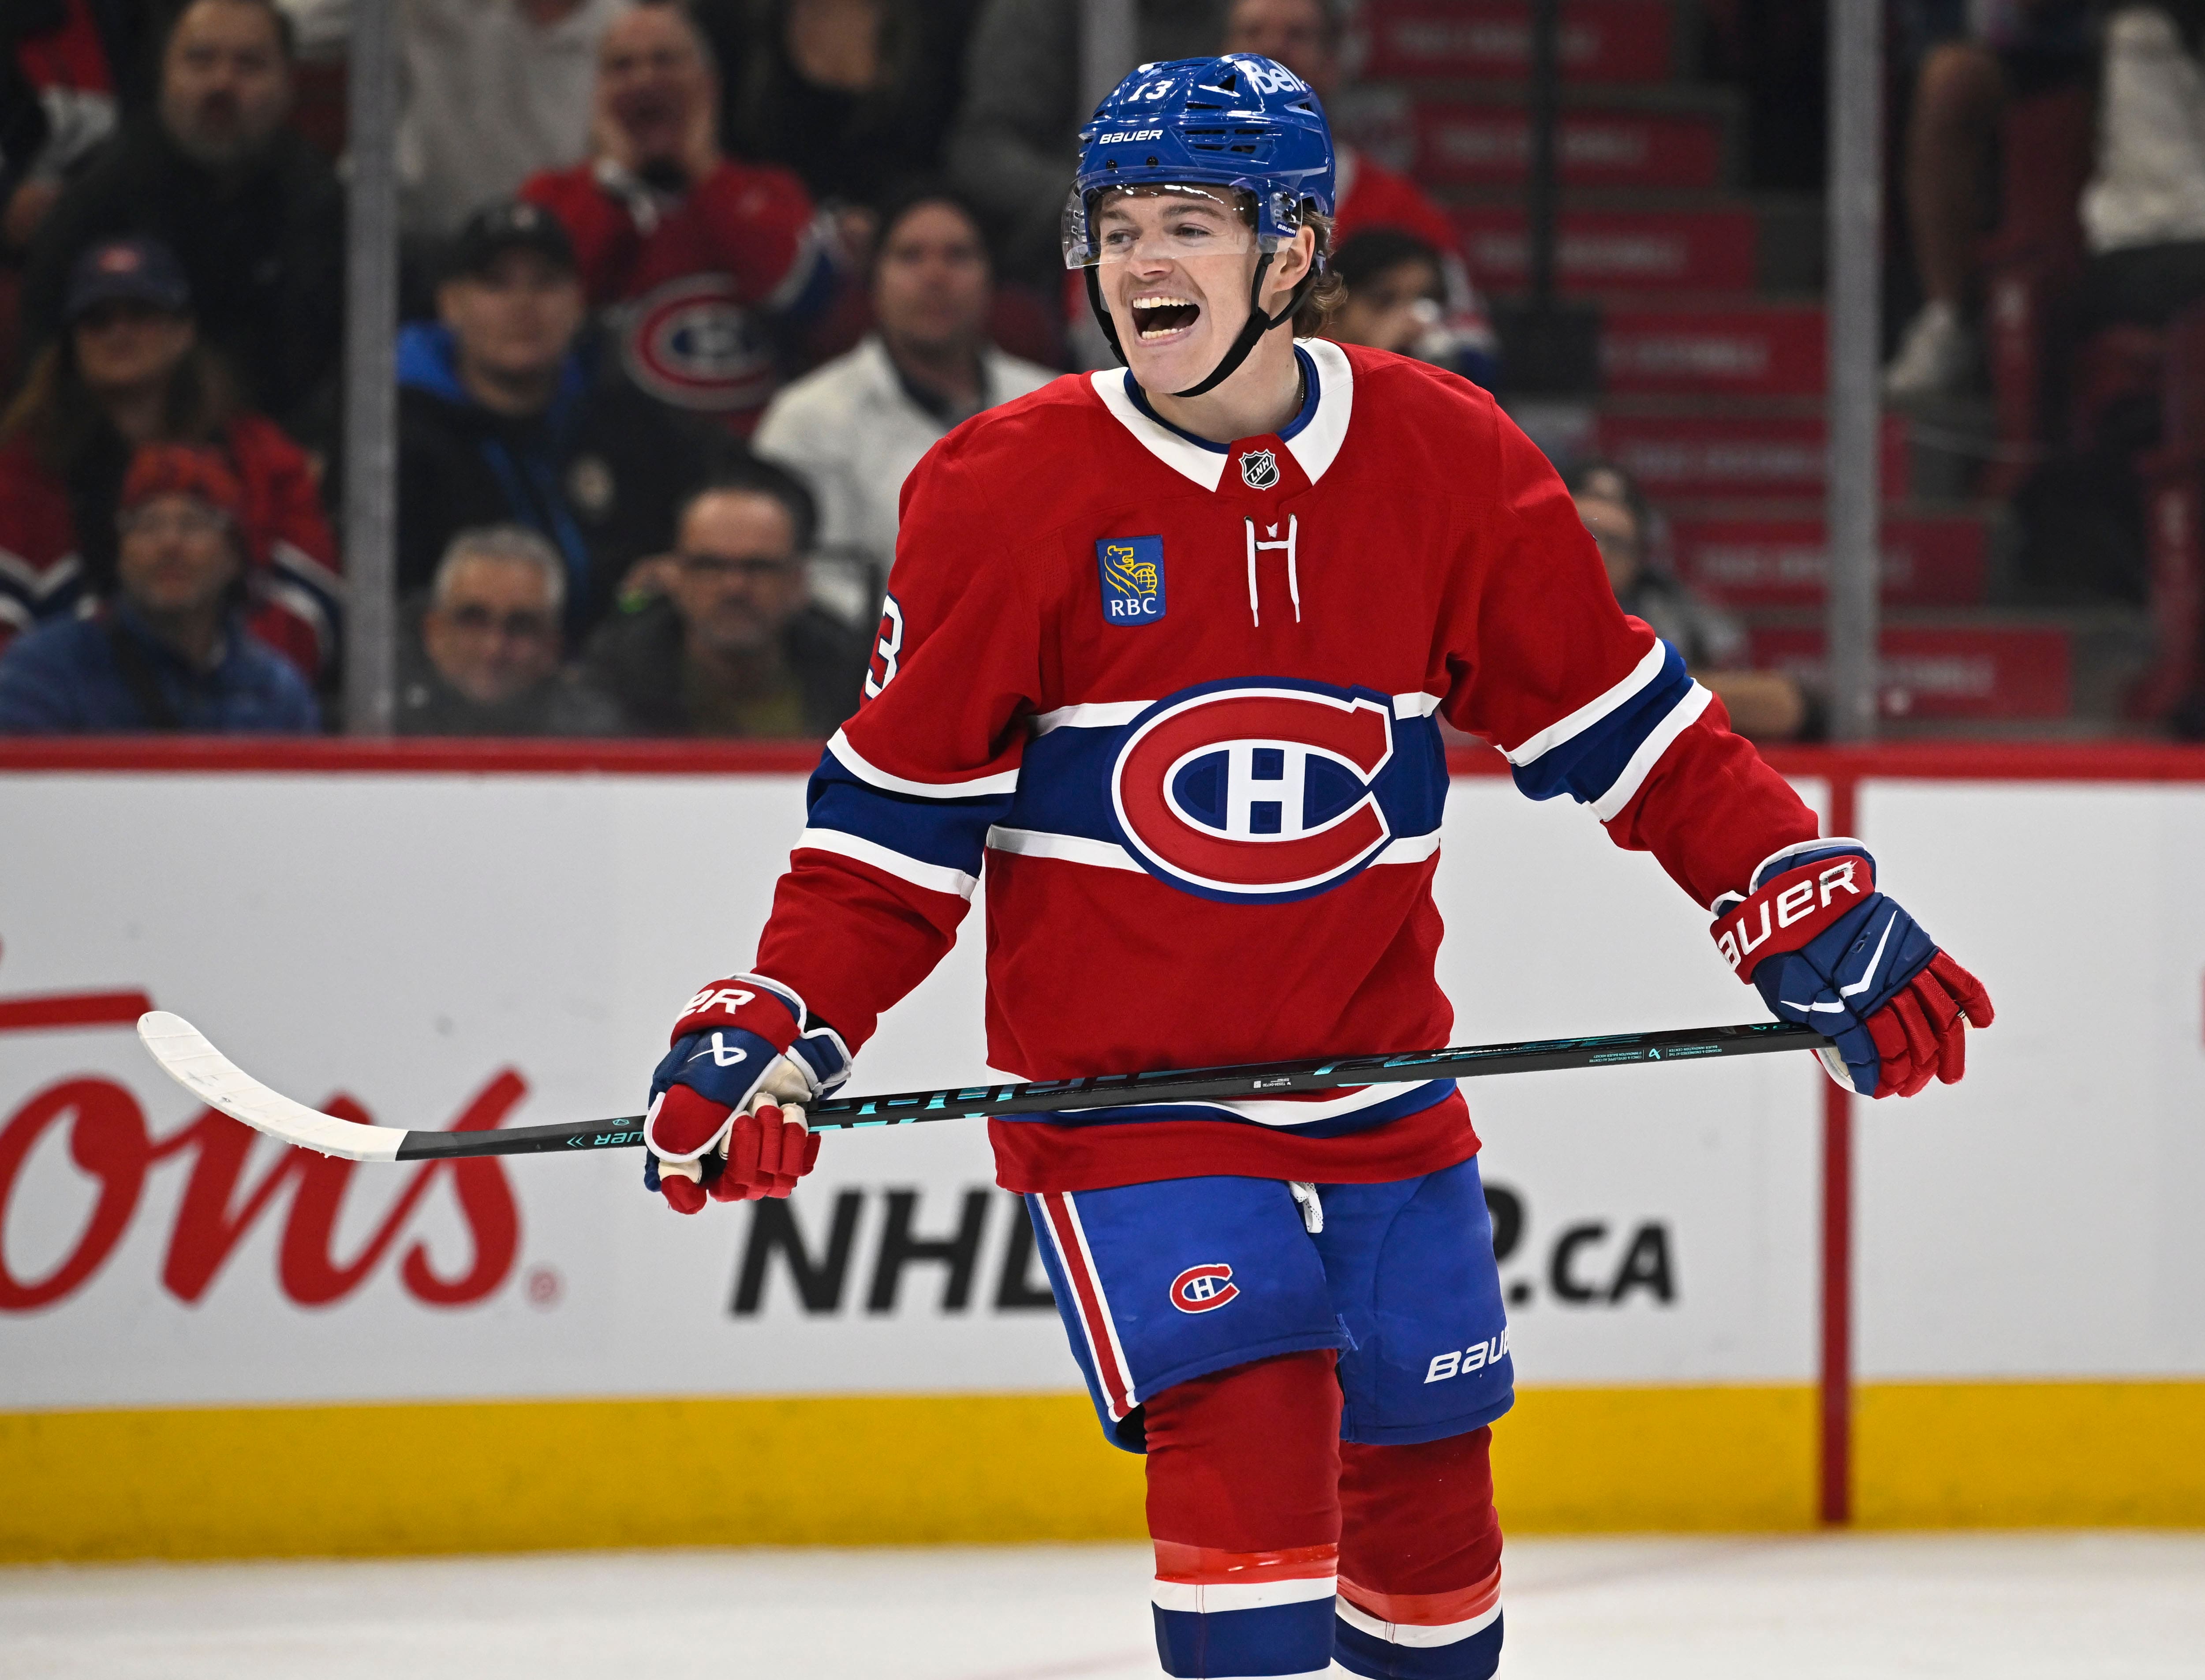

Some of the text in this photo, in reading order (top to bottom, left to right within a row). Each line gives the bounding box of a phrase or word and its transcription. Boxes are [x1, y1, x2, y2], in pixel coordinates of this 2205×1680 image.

[1128, 80, 1174, 101] 13
[1234, 59, 1307, 94] Bell
[1250, 457, 1269, 482] LNH
[1110, 597, 1157, 617] RBC
[865, 593, 903, 699] 3
[0, 990, 528, 1313] ons
